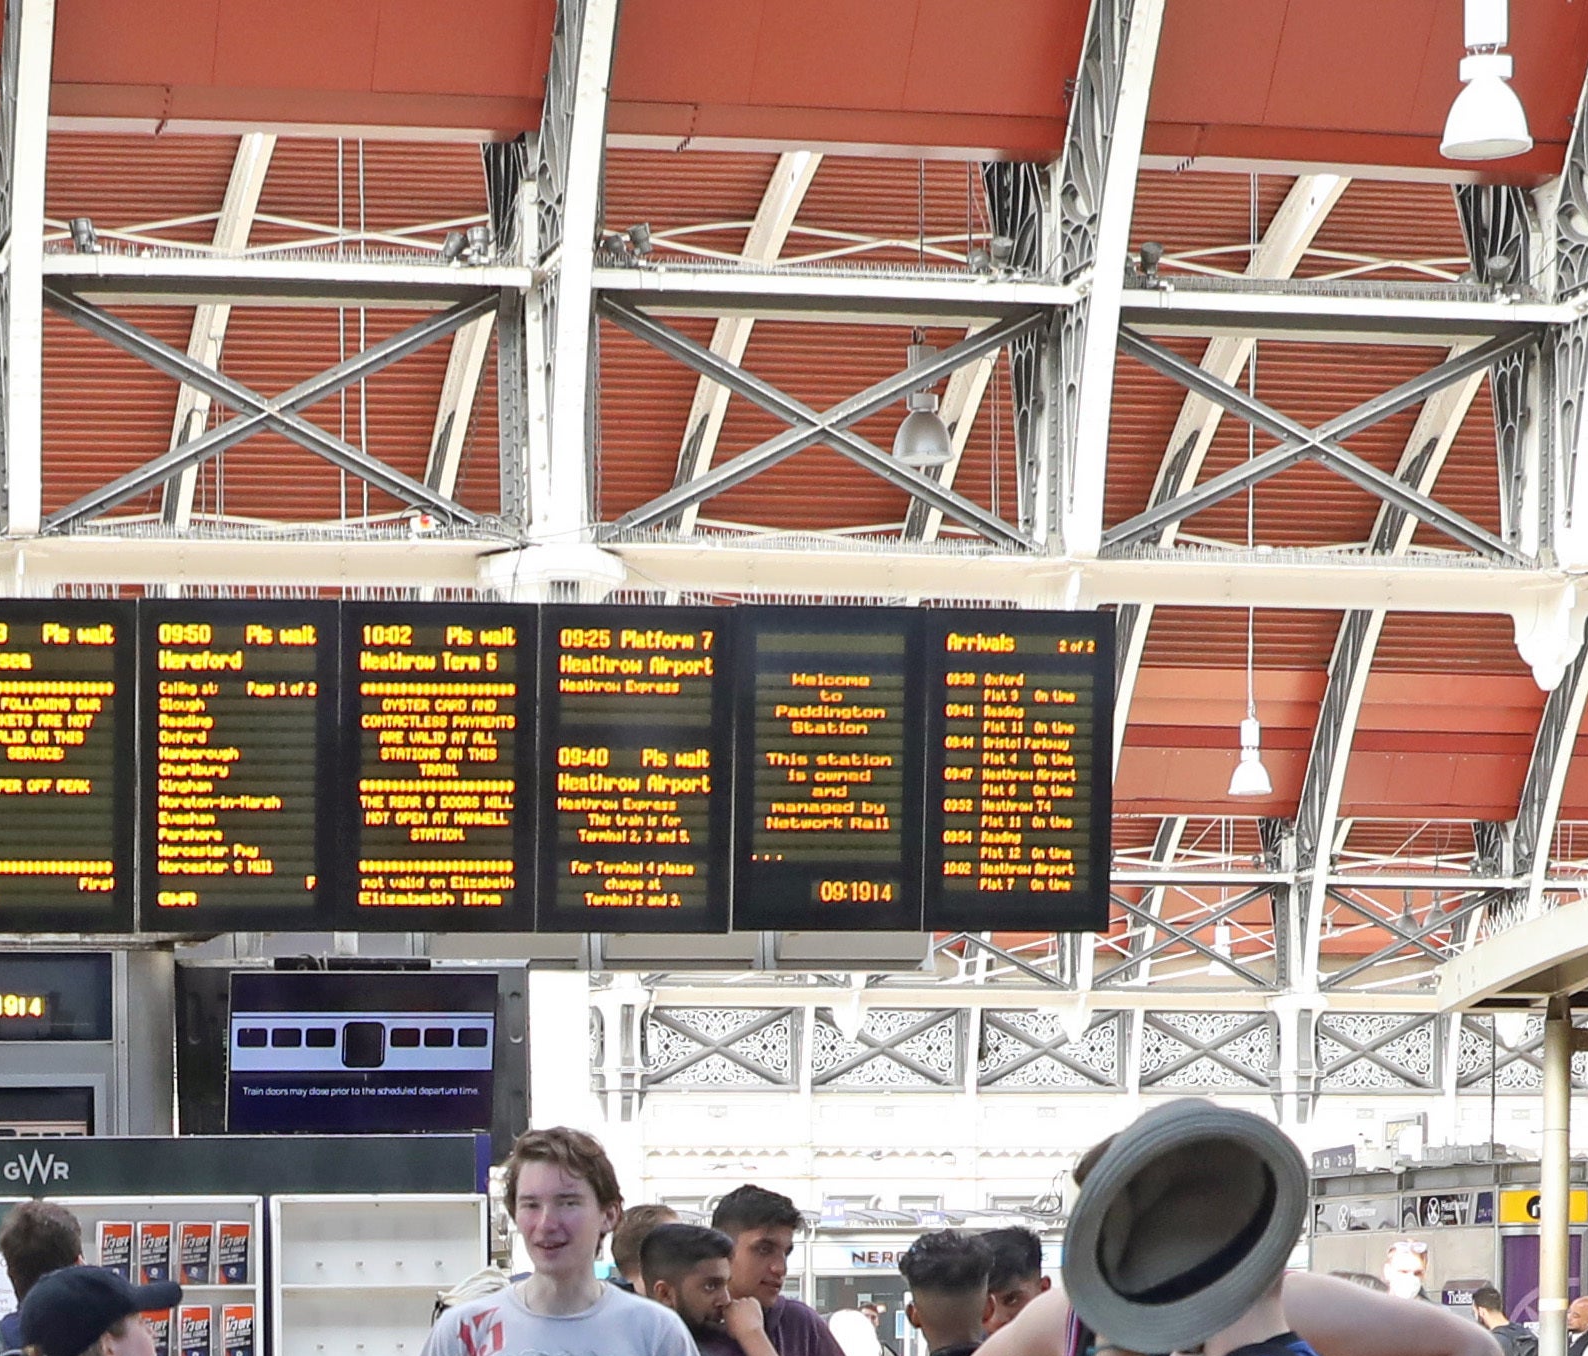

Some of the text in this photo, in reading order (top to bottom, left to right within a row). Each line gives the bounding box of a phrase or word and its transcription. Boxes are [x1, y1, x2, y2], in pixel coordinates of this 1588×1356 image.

[159, 624, 317, 645] 09:50 Pls wait
[364, 626, 516, 646] 10:02 Pls wait
[560, 629, 713, 650] 09:25 Platform 7
[947, 633, 1015, 652] Arrivals
[159, 650, 242, 670] Hereford
[560, 655, 713, 677] Heathrow Airport
[792, 674, 870, 686] Welcome
[820, 690, 842, 702] to
[775, 705, 885, 719] Paddington
[792, 721, 867, 734] Station
[558, 748, 709, 768] 09:40 Pls wait
[766, 753, 891, 766] This station
[558, 773, 711, 795] Heathrow Airport
[812, 785, 847, 797] and
[772, 802, 885, 814] managed by
[766, 817, 889, 829] Network Rail
[242, 1086, 480, 1098] Train doors may close prior to the scheduled departure time.
[3, 1149, 70, 1185] GWR
[1447, 1289, 1473, 1304] Tickets
